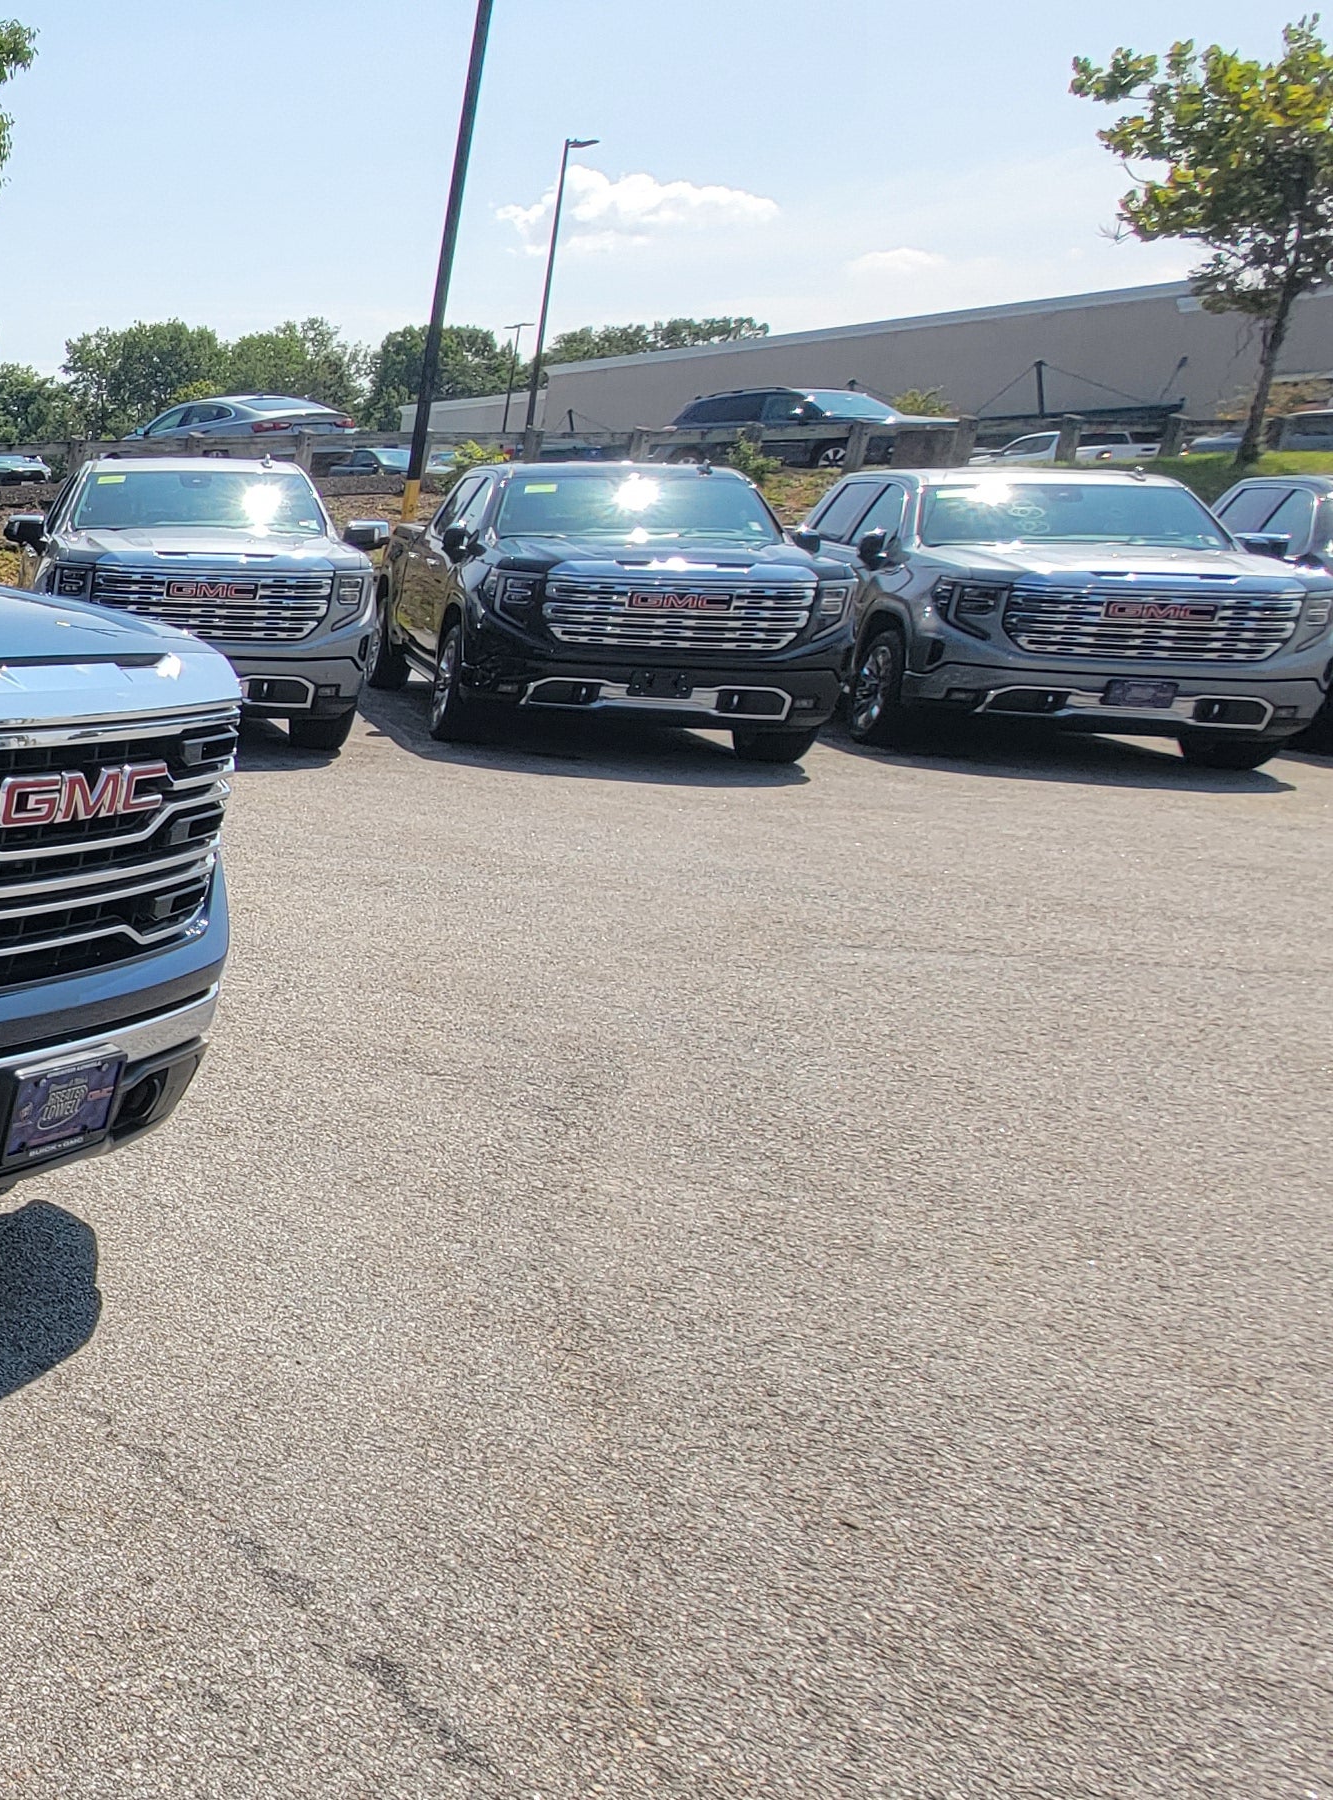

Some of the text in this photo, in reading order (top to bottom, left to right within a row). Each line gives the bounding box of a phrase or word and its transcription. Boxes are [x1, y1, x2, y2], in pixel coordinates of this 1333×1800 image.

[169, 582, 255, 599] GMC
[633, 592, 730, 610] GMC
[1109, 602, 1215, 620] GMC
[42, 1098, 81, 1121] LOWELL
